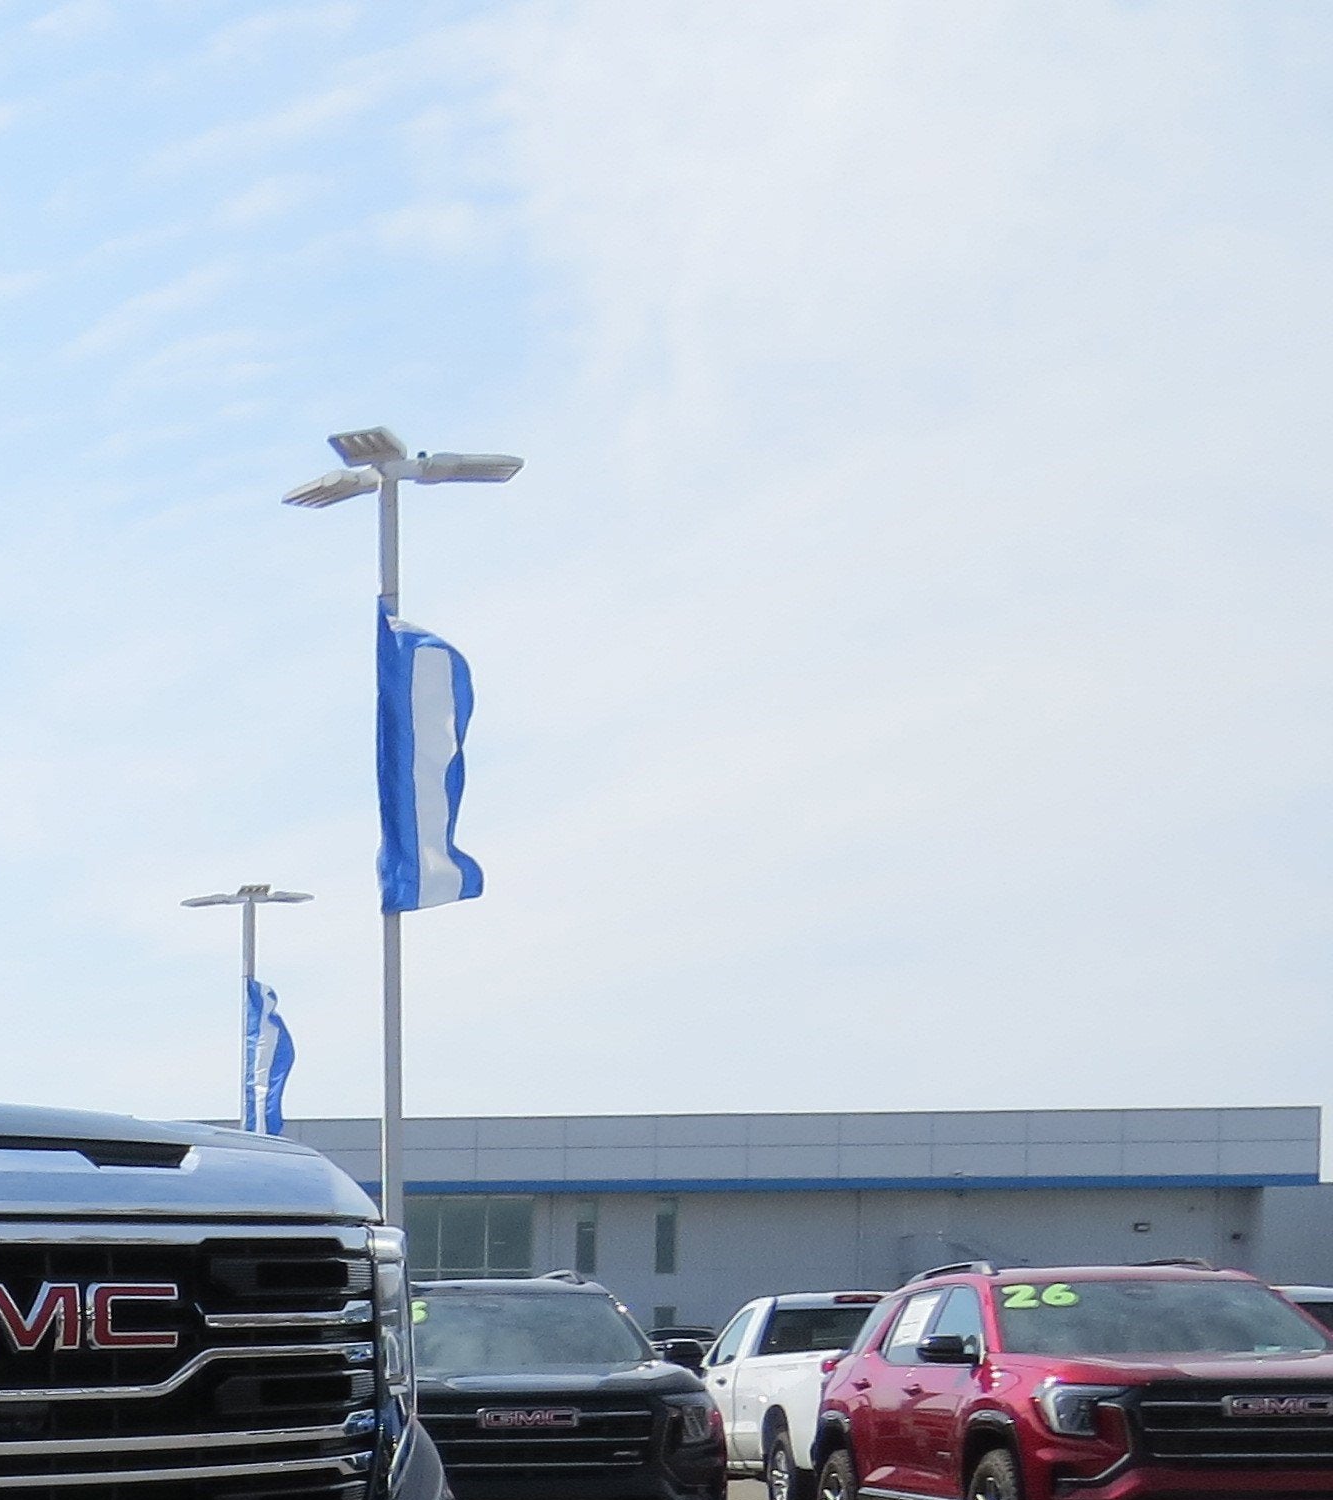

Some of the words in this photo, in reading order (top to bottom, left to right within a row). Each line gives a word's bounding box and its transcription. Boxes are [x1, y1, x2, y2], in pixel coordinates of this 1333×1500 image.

[1001, 1283, 1080, 1309] 26
[1232, 1397, 1331, 1416] GMC
[485, 1408, 575, 1427] GMC
